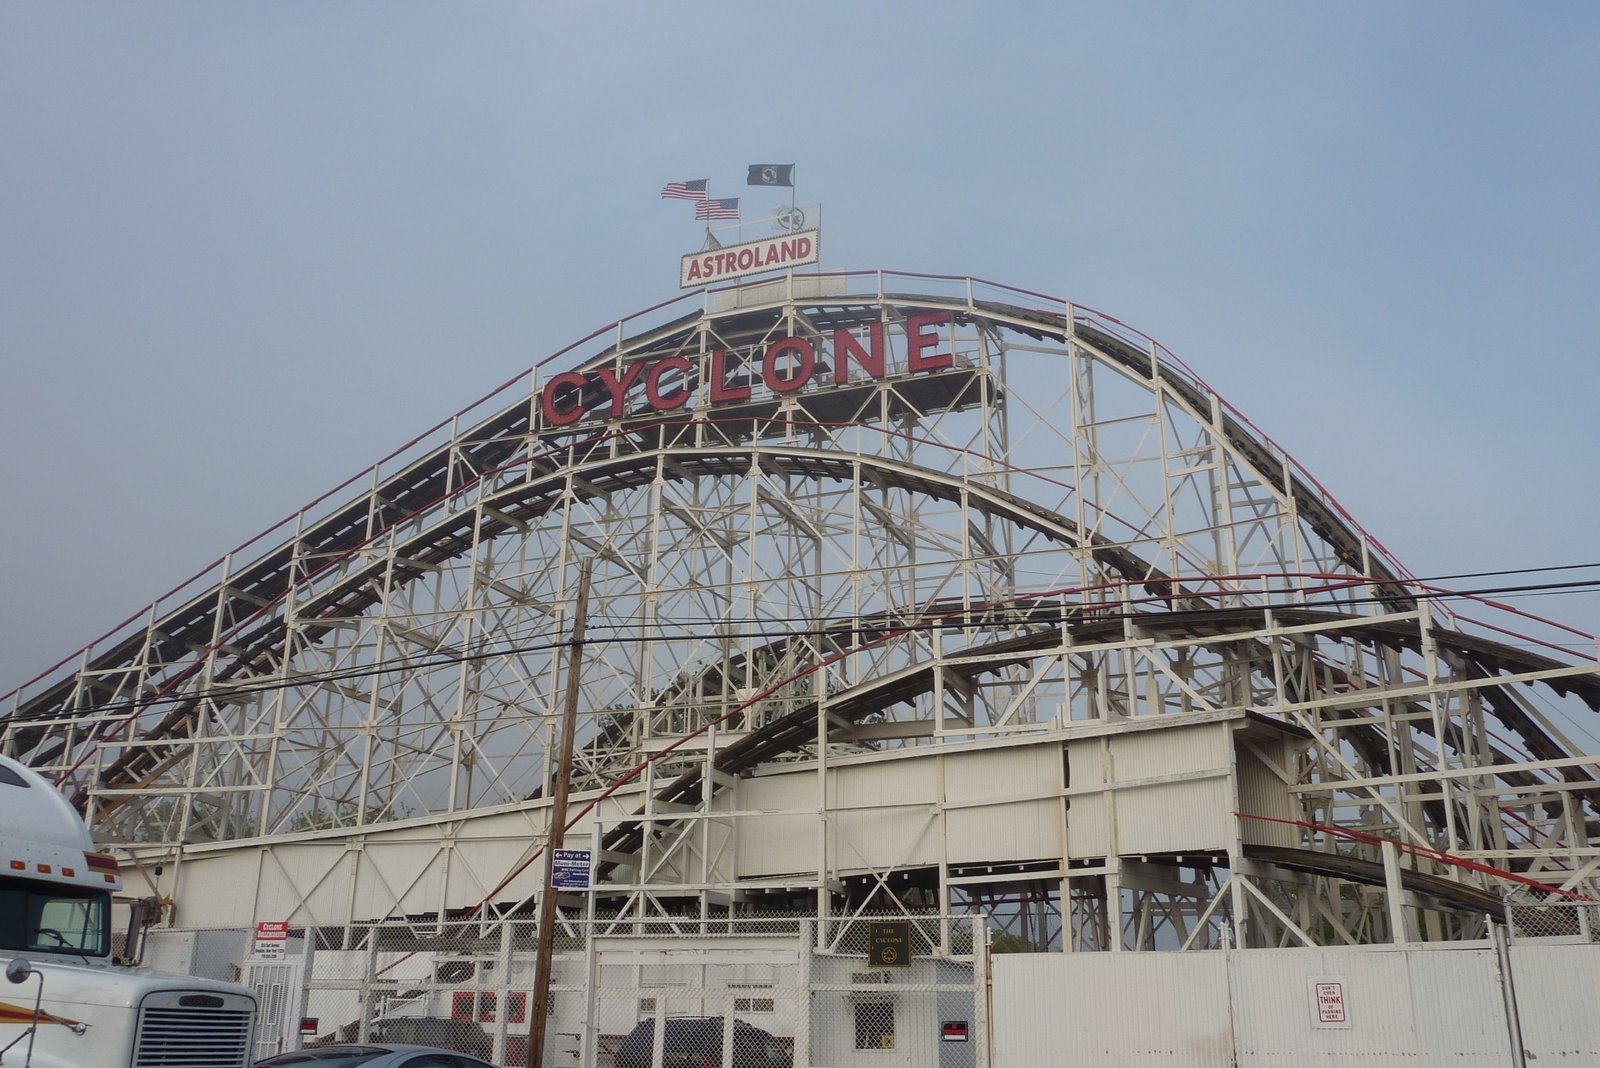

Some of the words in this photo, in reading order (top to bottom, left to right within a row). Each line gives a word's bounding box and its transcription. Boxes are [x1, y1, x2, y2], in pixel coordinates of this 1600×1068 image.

[687, 237, 811, 281] ASTROLAND
[541, 311, 954, 427] CYCLONE
[1320, 996, 1340, 1004] THINK
